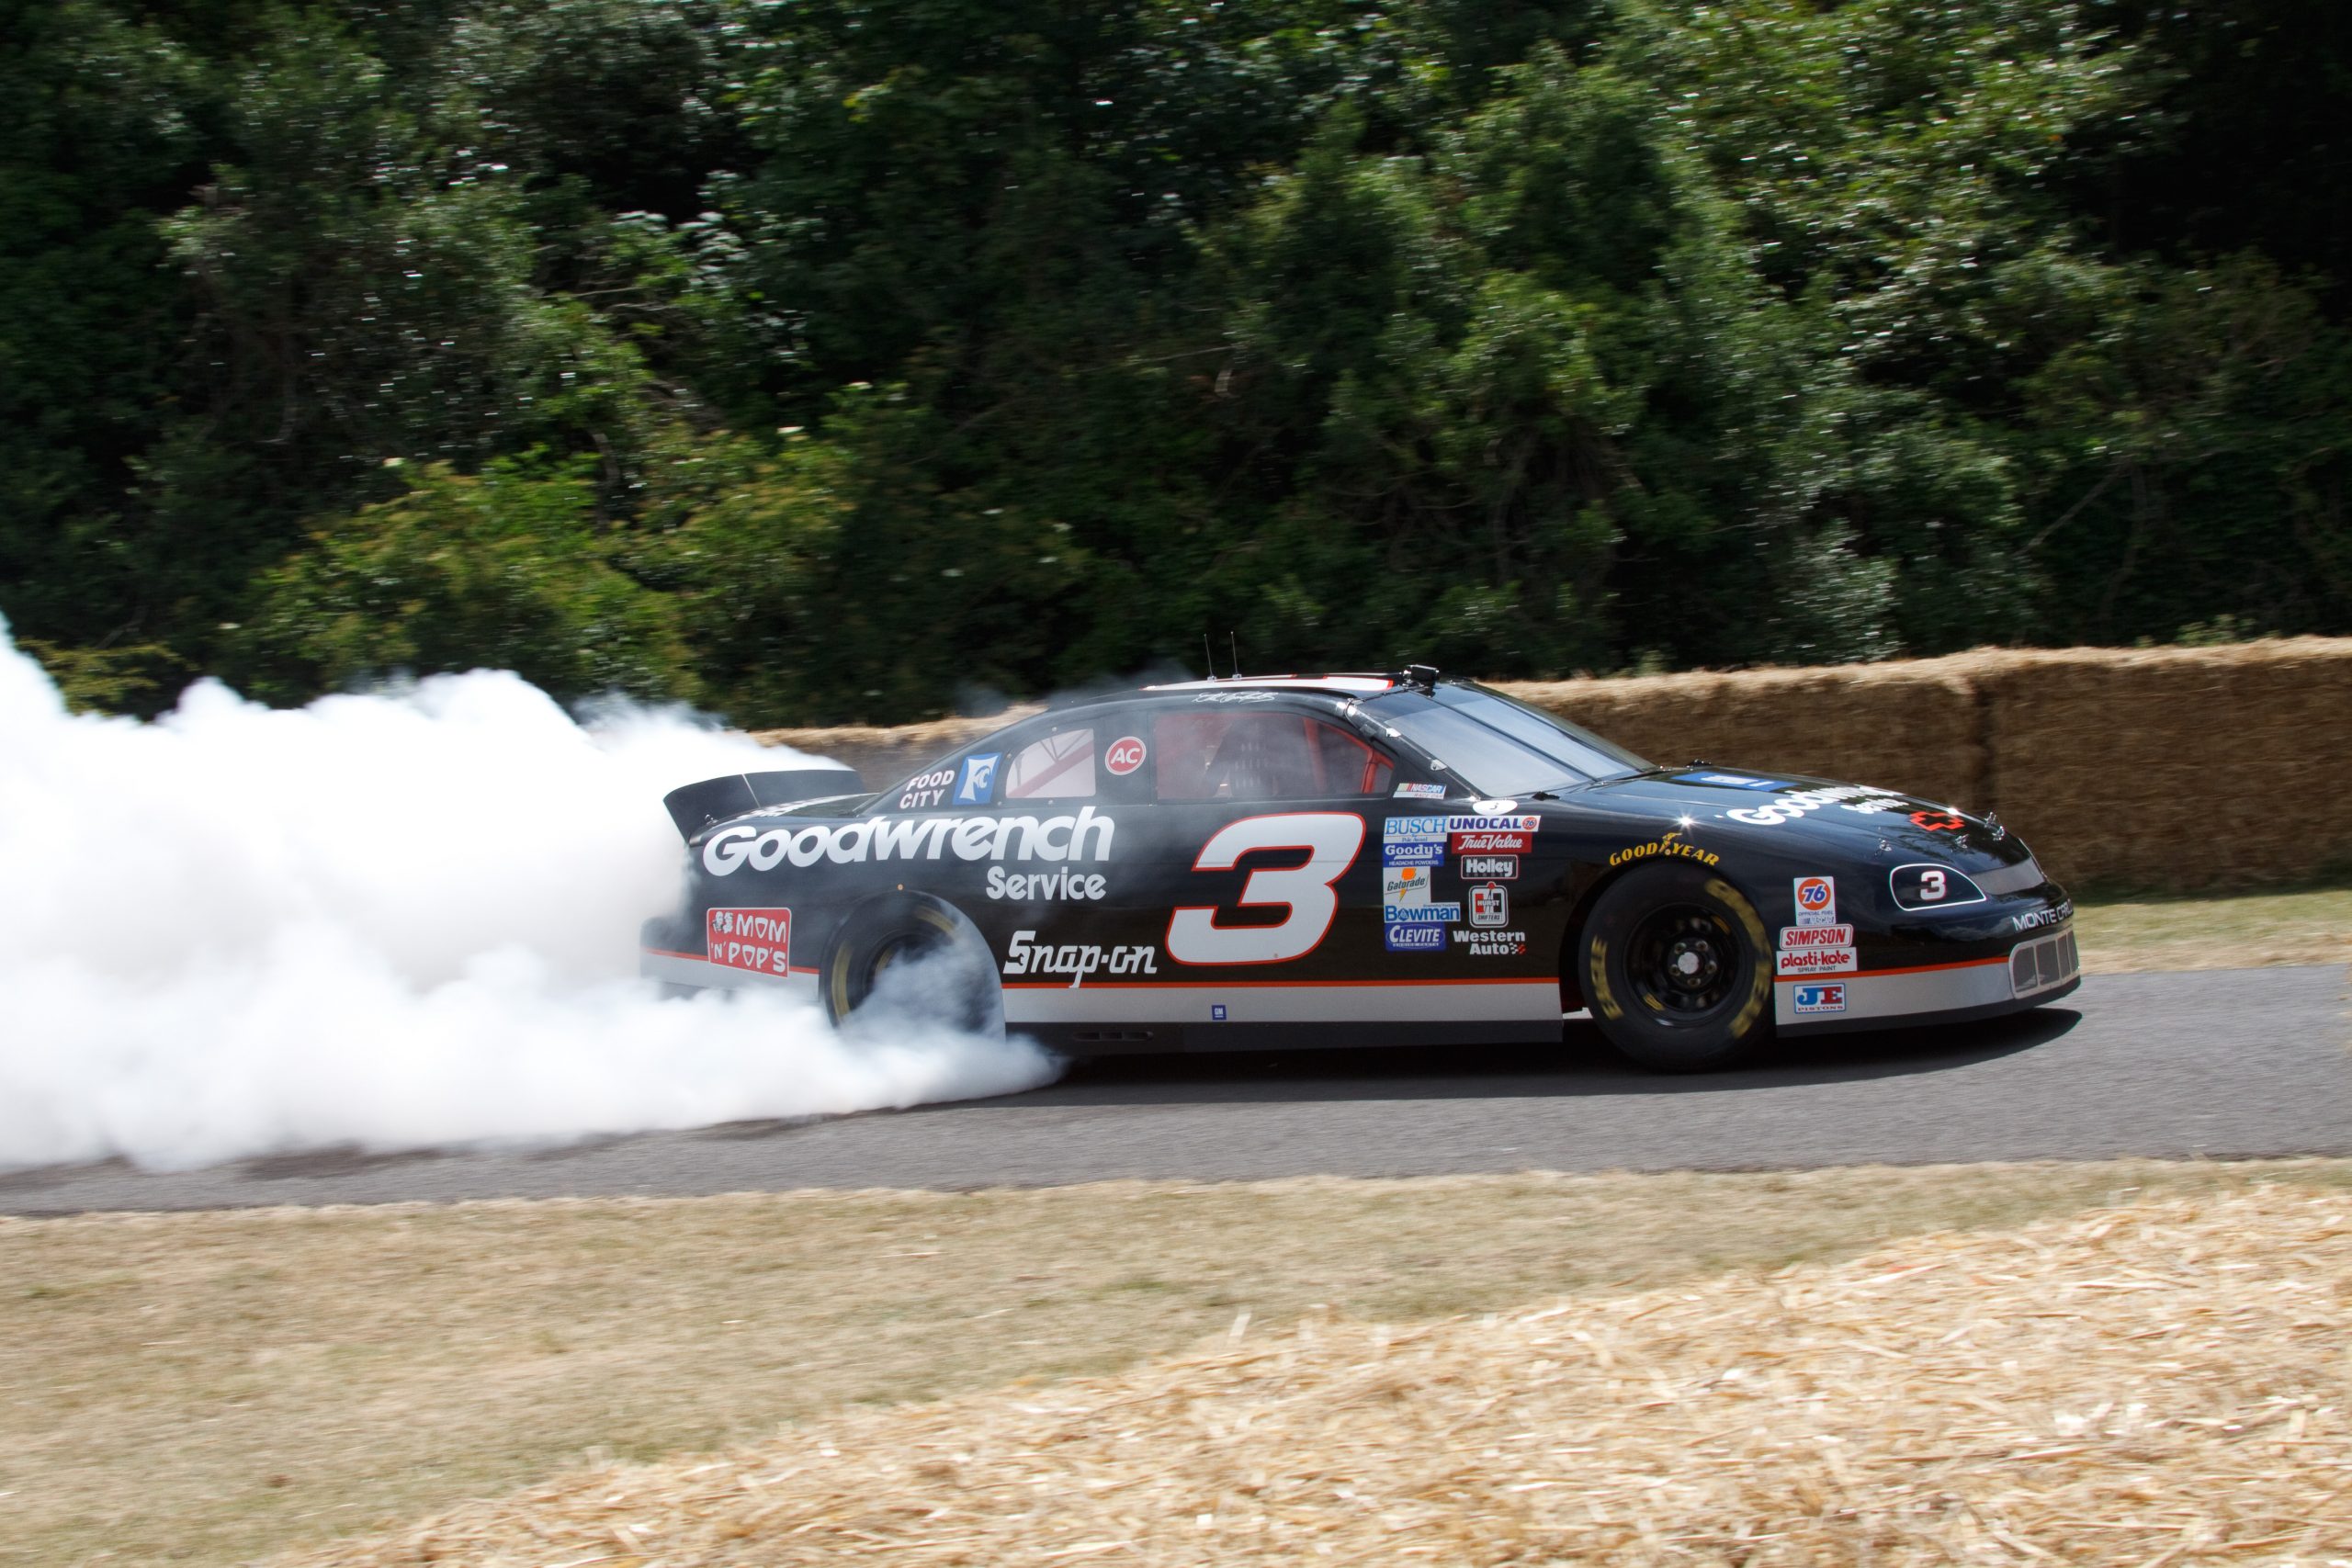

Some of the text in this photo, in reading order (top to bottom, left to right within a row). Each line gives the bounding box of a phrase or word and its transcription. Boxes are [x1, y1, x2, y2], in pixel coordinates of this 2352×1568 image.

[1111, 747, 1140, 764] AC
[906, 770, 955, 791] FOOD
[1411, 783, 1443, 794] NASCAR
[899, 789, 944, 809] CITY
[1385, 818, 1447, 835] BUSCH
[1449, 818, 1523, 830] UNOCAL
[703, 806, 1114, 876] Goodwrench
[1385, 843, 1442, 861] Goody's
[1465, 858, 1513, 877] Holley
[986, 865, 1107, 900] Service
[1165, 811, 1366, 965] 3
[1387, 876, 1426, 892] Gatorade
[1920, 870, 1947, 901] 3
[1802, 883, 1828, 904] 76
[1385, 905, 1460, 921] Bowman
[2012, 908, 2057, 931] MONTE
[736, 913, 786, 943] MOM
[1389, 925, 1441, 943] CLEVITE
[1453, 931, 1526, 942] Western
[1785, 929, 1847, 946] SIMPSON
[729, 942, 786, 973] POP'S
[1470, 942, 1510, 955] Auto
[1003, 931, 1158, 988] Snap-on
[1781, 950, 1850, 969] plasti-kote
[1797, 987, 1843, 1006] JE
